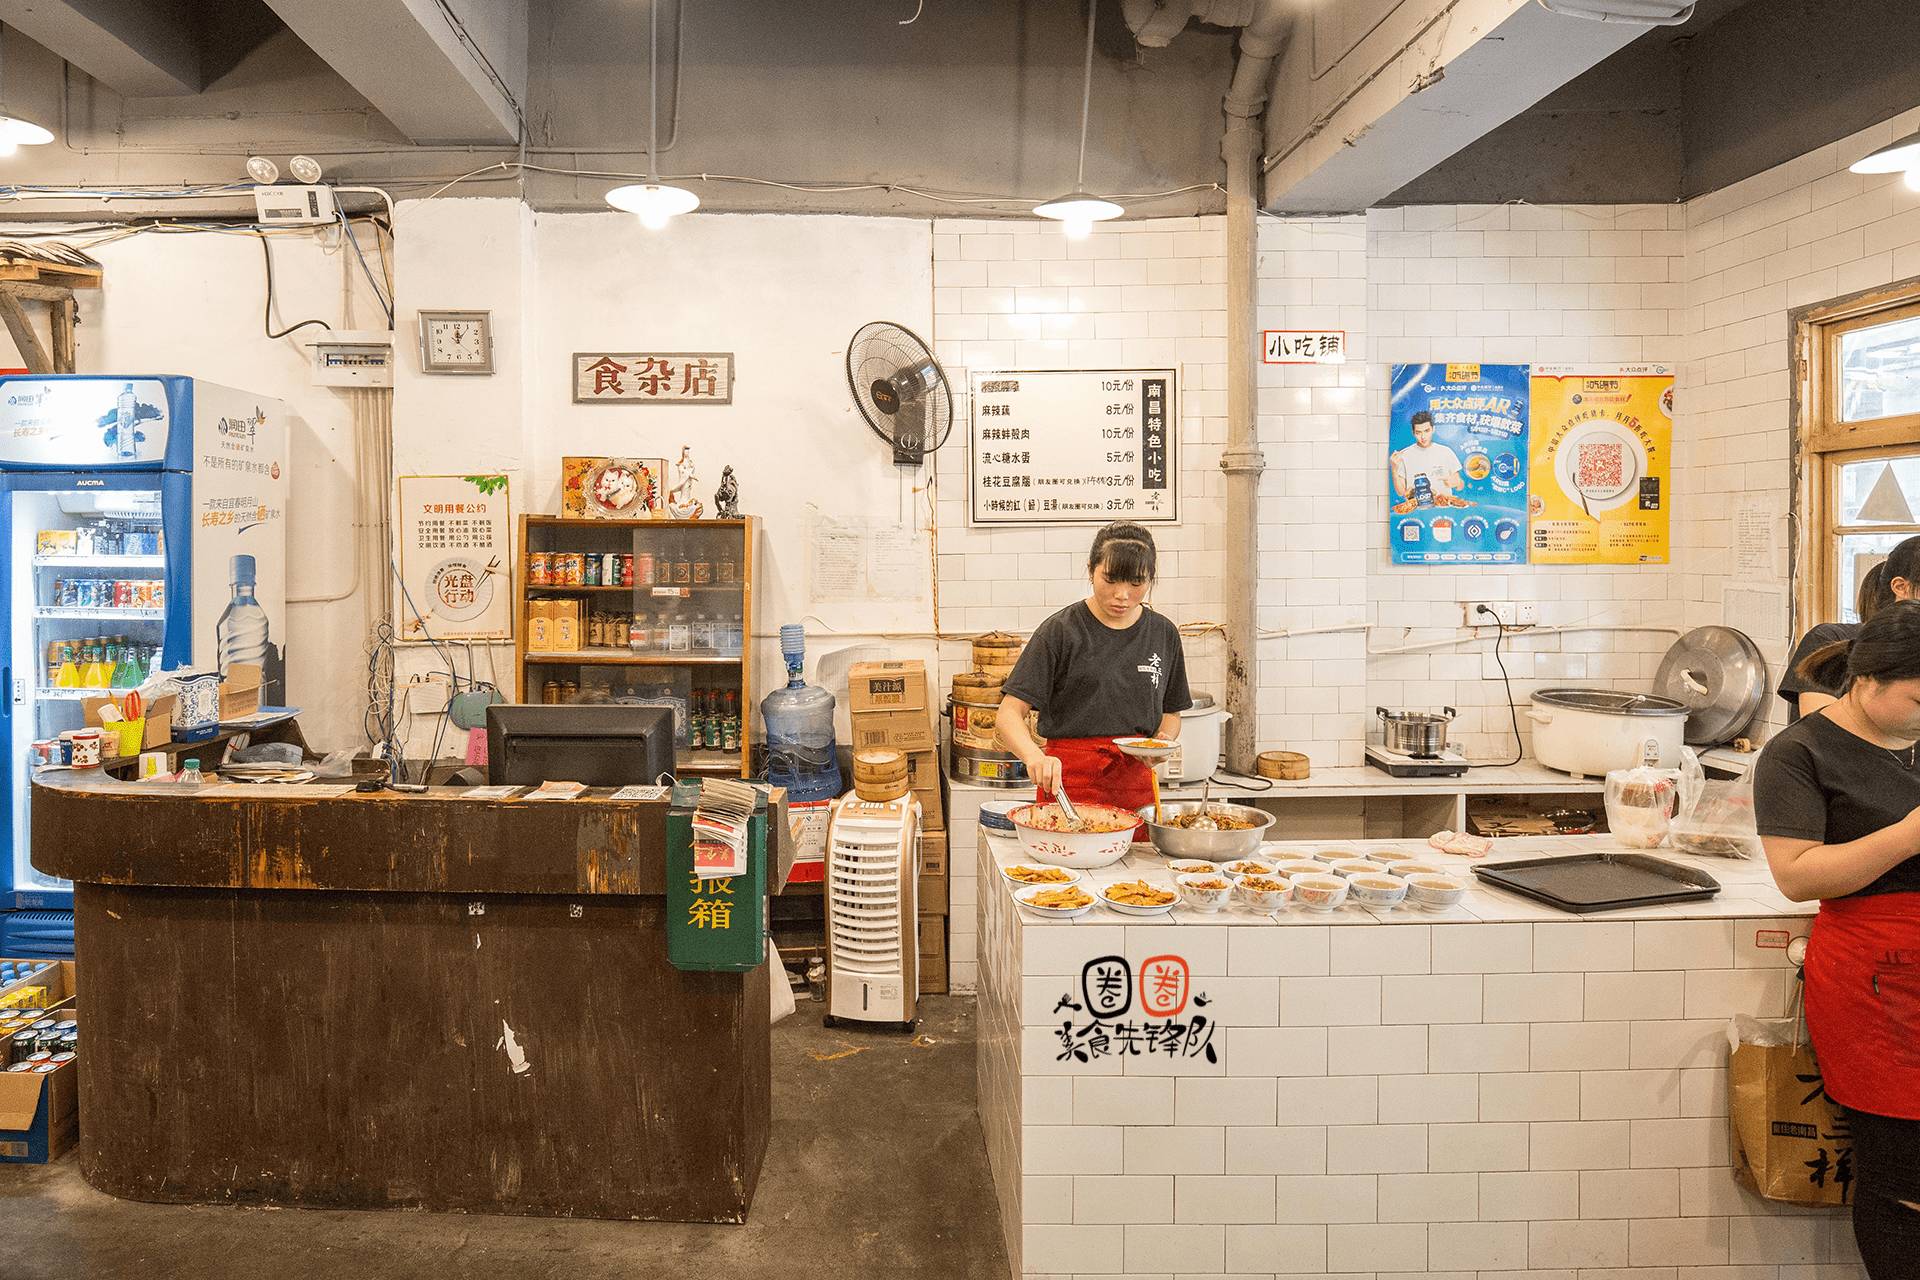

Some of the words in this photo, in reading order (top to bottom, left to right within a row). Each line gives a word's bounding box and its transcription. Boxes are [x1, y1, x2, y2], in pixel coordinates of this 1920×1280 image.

[585, 356, 720, 397] 食杂店
[1101, 379, 1135, 392] 10元/份
[1105, 403, 1135, 416] 8元/份
[1101, 426, 1135, 440] 10元/份
[1147, 383, 1162, 482] 南昌特色小吃
[982, 451, 1031, 465] 流心糖水蛋
[1106, 450, 1135, 463] 5元/份
[1106, 475, 1135, 487] 3元/份
[423, 504, 487, 514] 文明用餐公约
[1106, 498, 1135, 510] 3元/份
[444, 574, 475, 589] 光盘
[444, 589, 475, 603] 行动
[873, 681, 902, 693] 美汁源
[687, 842, 735, 929] 报箱
